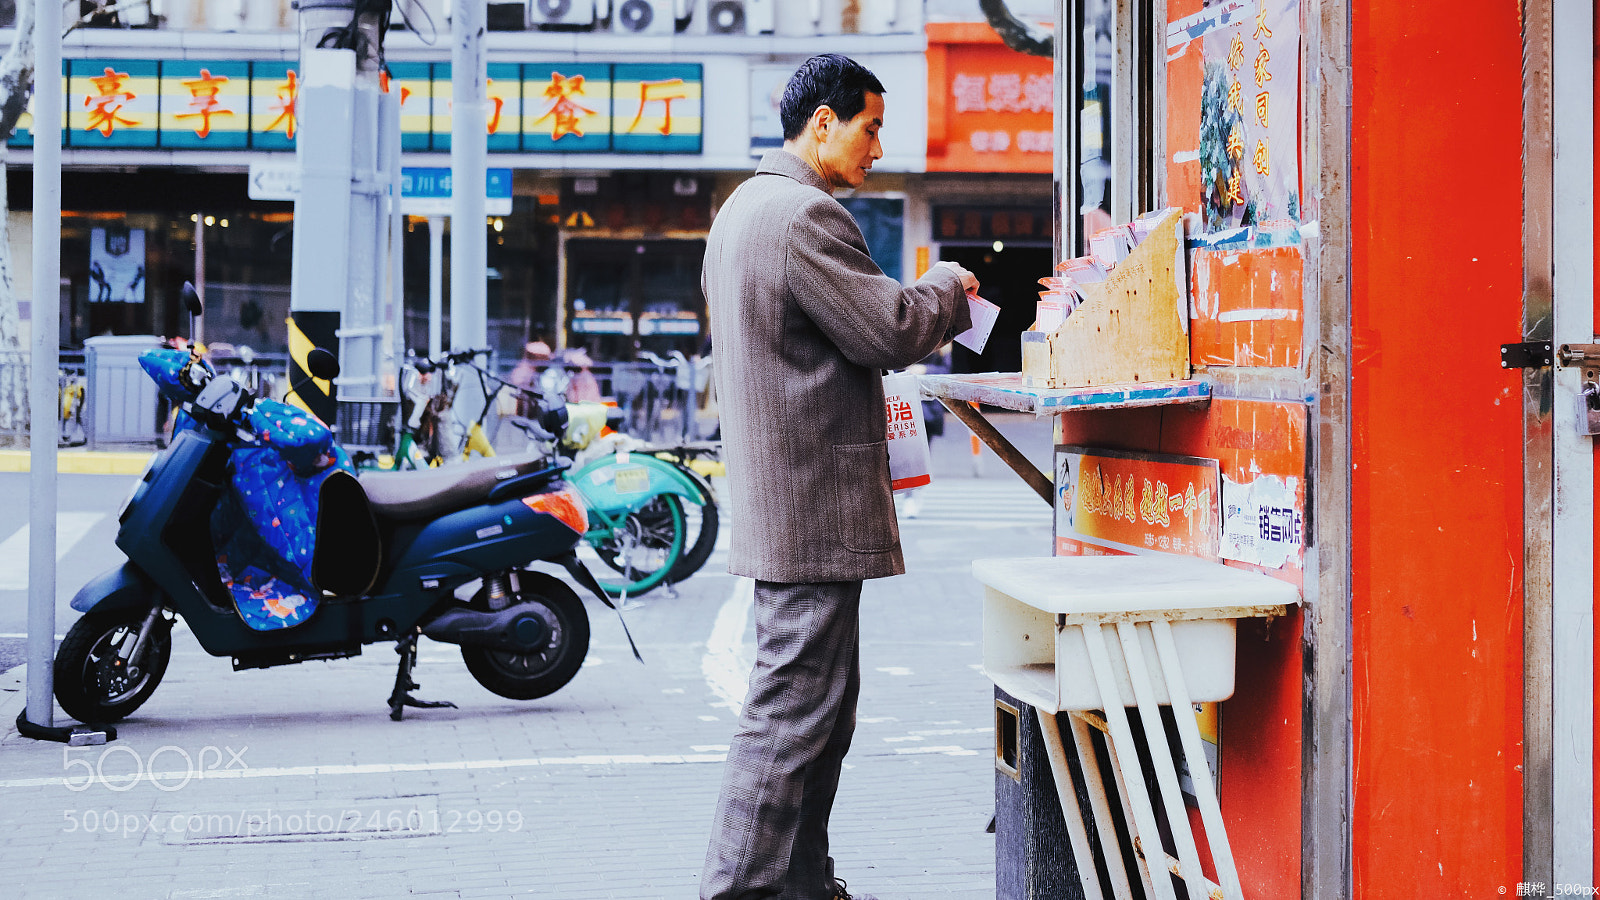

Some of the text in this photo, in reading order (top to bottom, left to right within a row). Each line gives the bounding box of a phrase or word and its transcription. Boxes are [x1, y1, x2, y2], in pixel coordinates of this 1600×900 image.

[83, 66, 688, 141] 豪享来餐厅
[1252, 0, 1273, 176] 大家同创
